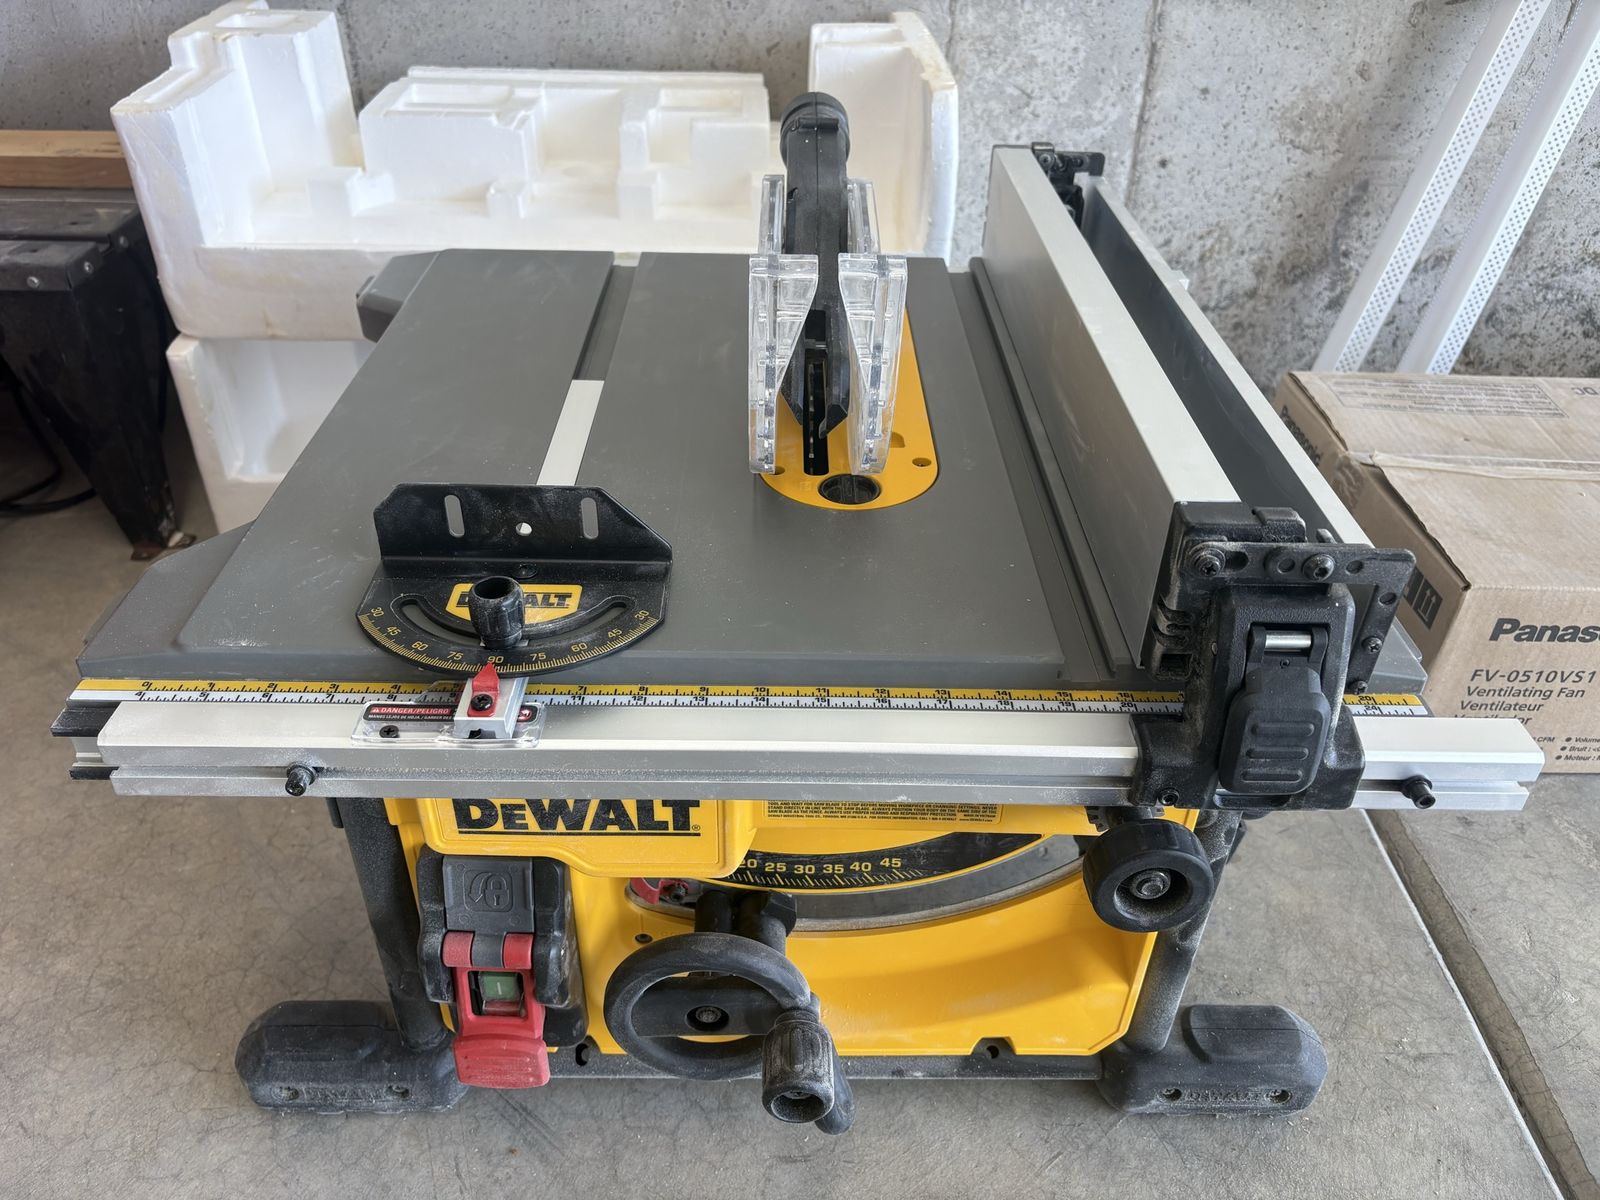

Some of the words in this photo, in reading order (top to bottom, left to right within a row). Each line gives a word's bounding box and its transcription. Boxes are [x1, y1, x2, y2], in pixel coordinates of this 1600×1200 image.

[457, 592, 571, 606] DALT
[371, 607, 384, 617] 30
[387, 626, 401, 635] 45
[412, 641, 428, 651] 60
[447, 651, 463, 660] 75
[530, 653, 546, 661] 75
[571, 642, 587, 652] 60
[608, 628, 622, 638] 45
[635, 610, 649, 620] 30
[1489, 618, 1600, 643] Panas
[1470, 669, 1597, 683] FV-0510VS1
[1467, 686, 1553, 700] Ventilating
[1557, 687, 1585, 698] Fan
[1460, 700, 1544, 712] Ventilateur
[452, 798, 700, 831] DEWALT
[765, 862, 787, 872] 25
[794, 864, 815, 874] 30
[823, 864, 844, 874] 35
[850, 862, 872, 872] 40
[880, 858, 902, 868] 45
